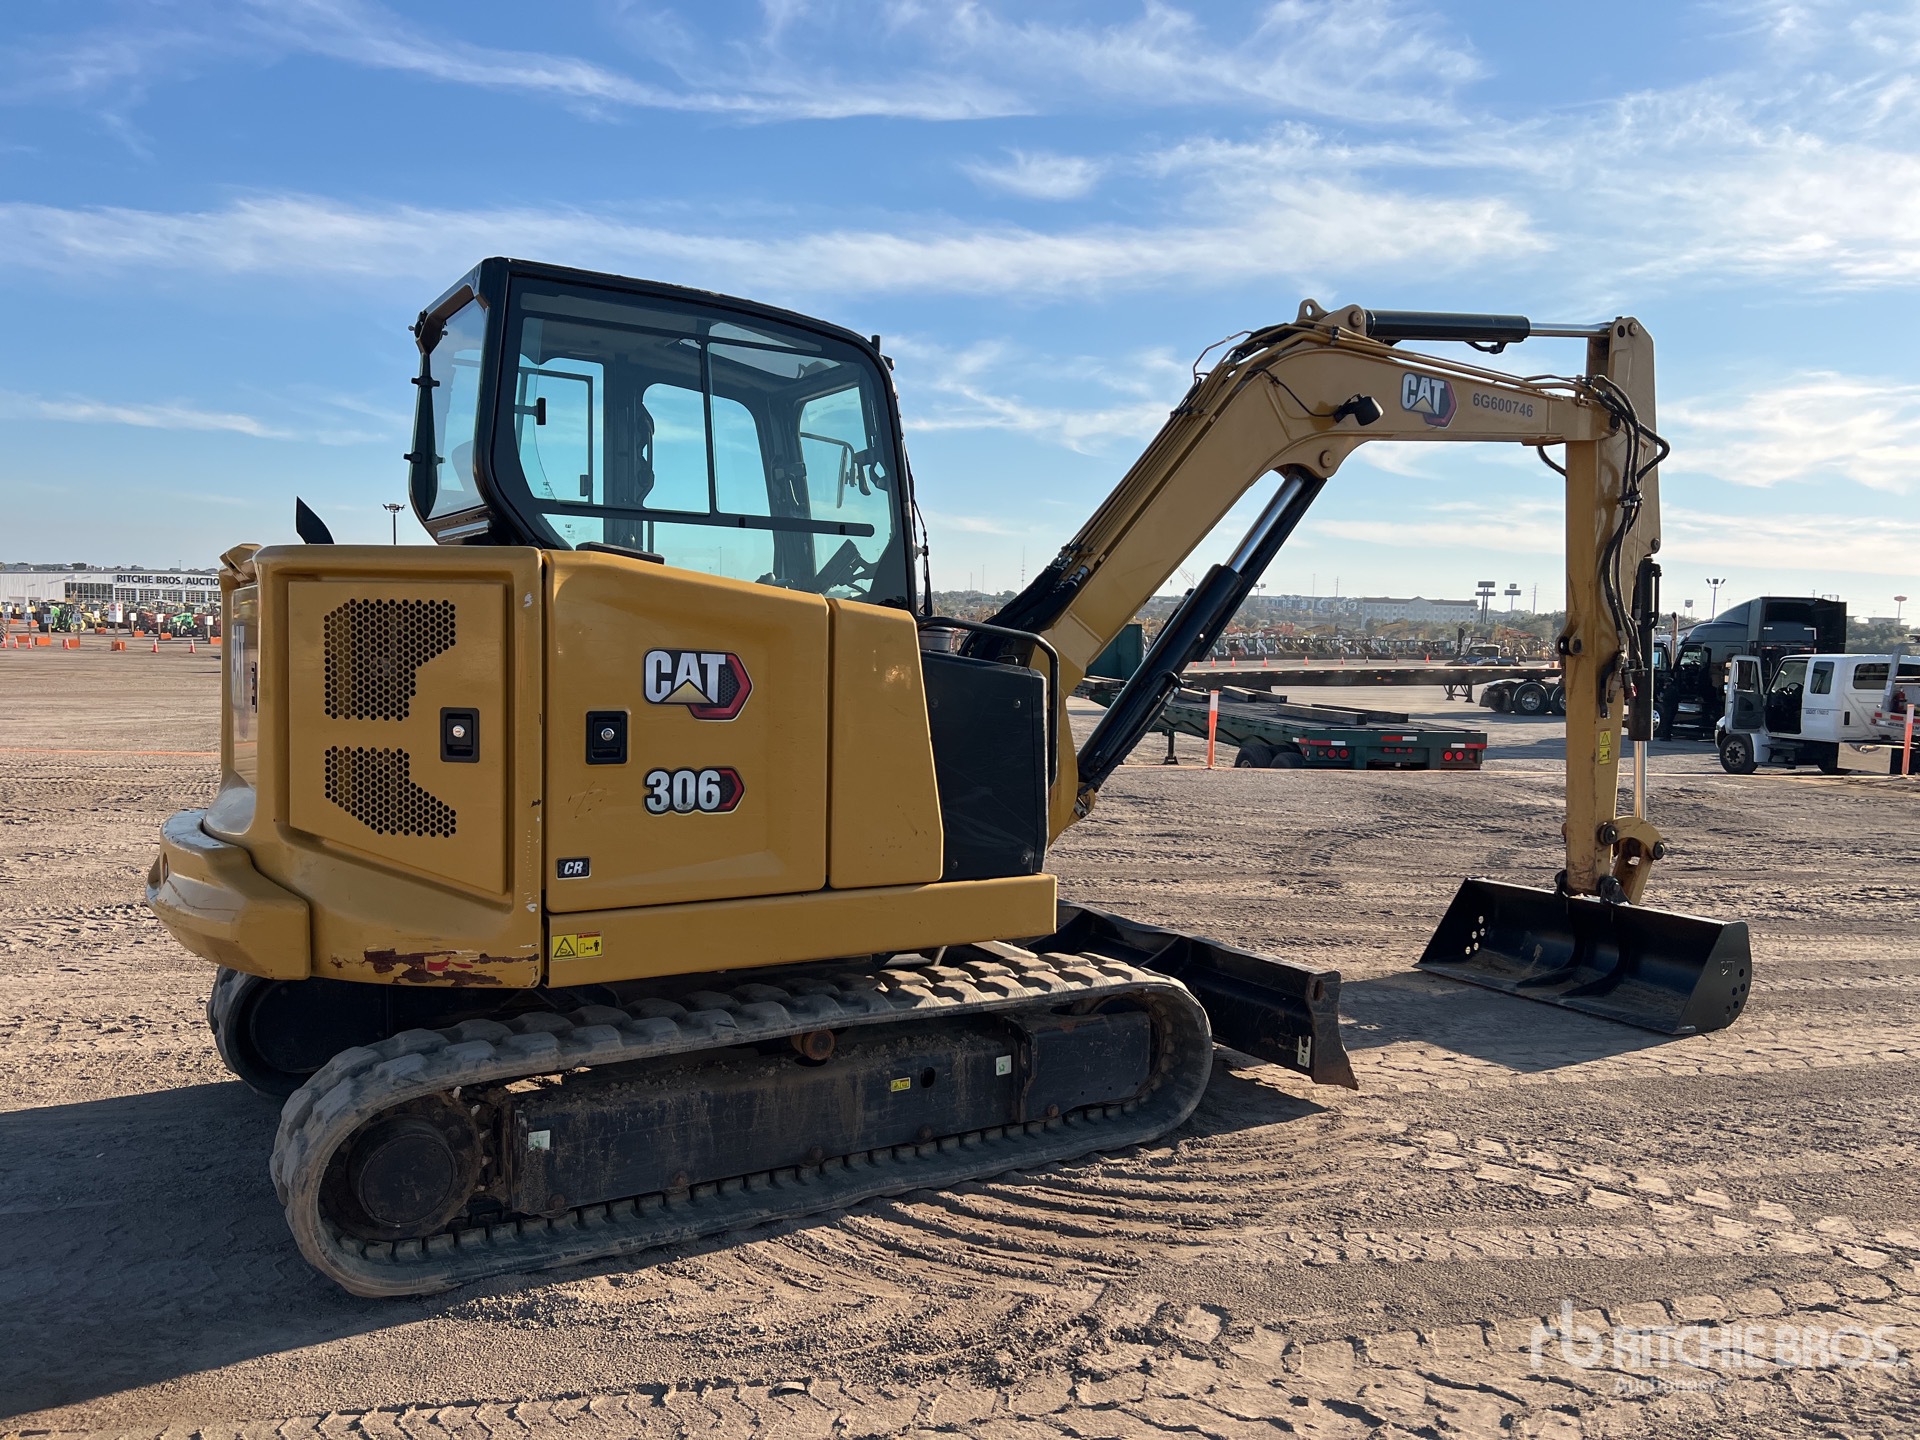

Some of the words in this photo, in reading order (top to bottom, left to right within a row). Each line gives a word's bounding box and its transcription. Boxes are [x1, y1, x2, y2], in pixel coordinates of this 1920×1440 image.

[1402, 373, 1444, 415] CAT
[1472, 392, 1533, 418] 6G600746
[116, 574, 153, 584] RITCHIE
[156, 576, 183, 585] BROS.
[645, 650, 726, 703] CAT
[646, 769, 721, 812] 306
[564, 861, 584, 875] CR
